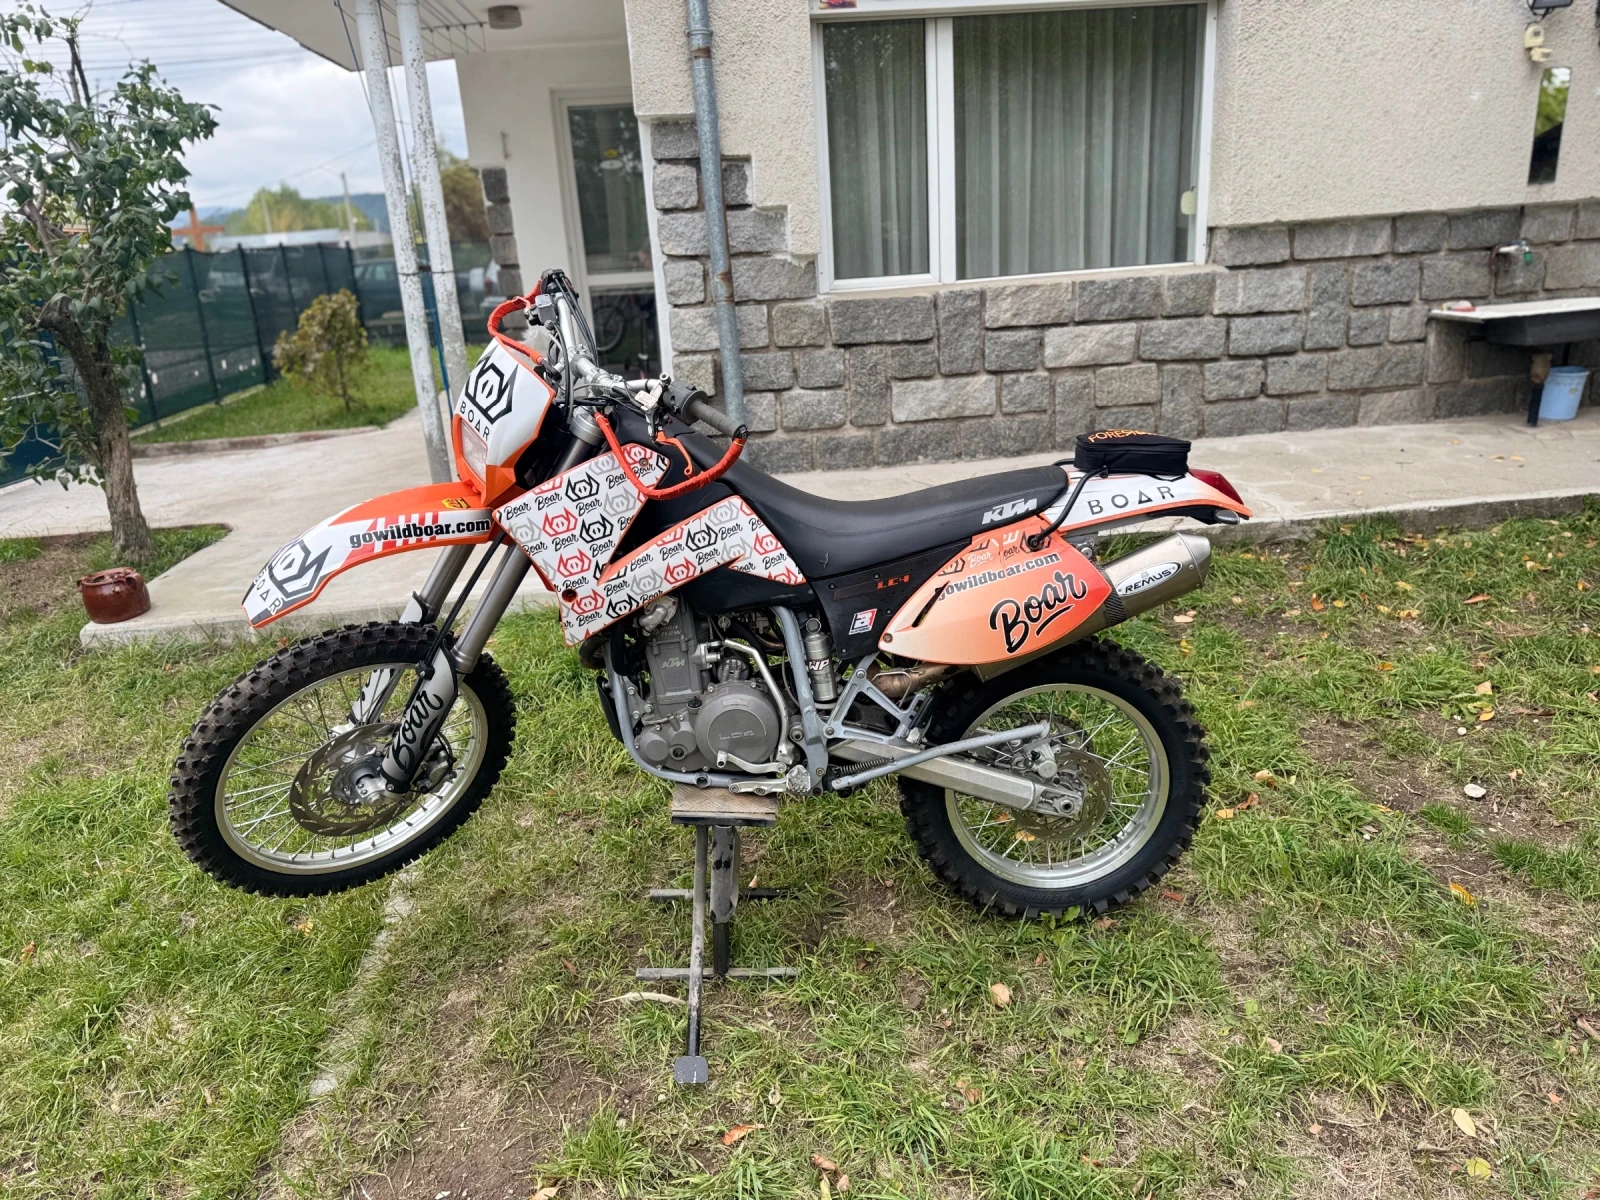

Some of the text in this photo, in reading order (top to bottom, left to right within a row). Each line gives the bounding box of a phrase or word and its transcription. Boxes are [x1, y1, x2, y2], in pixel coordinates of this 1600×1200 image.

[460, 401, 490, 441] BOAR
[1088, 429, 1158, 443] FORES
[535, 492, 562, 511] Boar
[576, 498, 602, 517] Boar
[1087, 486, 1175, 516] BOAR
[504, 502, 531, 520] Boar
[982, 498, 1038, 525] KTM
[618, 515, 636, 531] Bo
[718, 523, 743, 540] Boar
[749, 518, 765, 532] Bo
[349, 519, 491, 549] gowildboar.com
[552, 533, 579, 552] Boar
[590, 538, 616, 558] Boar
[660, 542, 685, 561] Boar
[696, 548, 721, 565] Boar
[630, 553, 654, 572] Boar
[762, 552, 787, 570] Boar
[968, 551, 994, 568] Boar
[604, 580, 630, 599] Boar
[1125, 569, 1172, 593] REMUS
[576, 611, 602, 628] Boar
[990, 571, 1087, 654] Boar
[661, 657, 687, 670] KTM
[808, 659, 830, 671] WP
[384, 690, 444, 776] Boar
